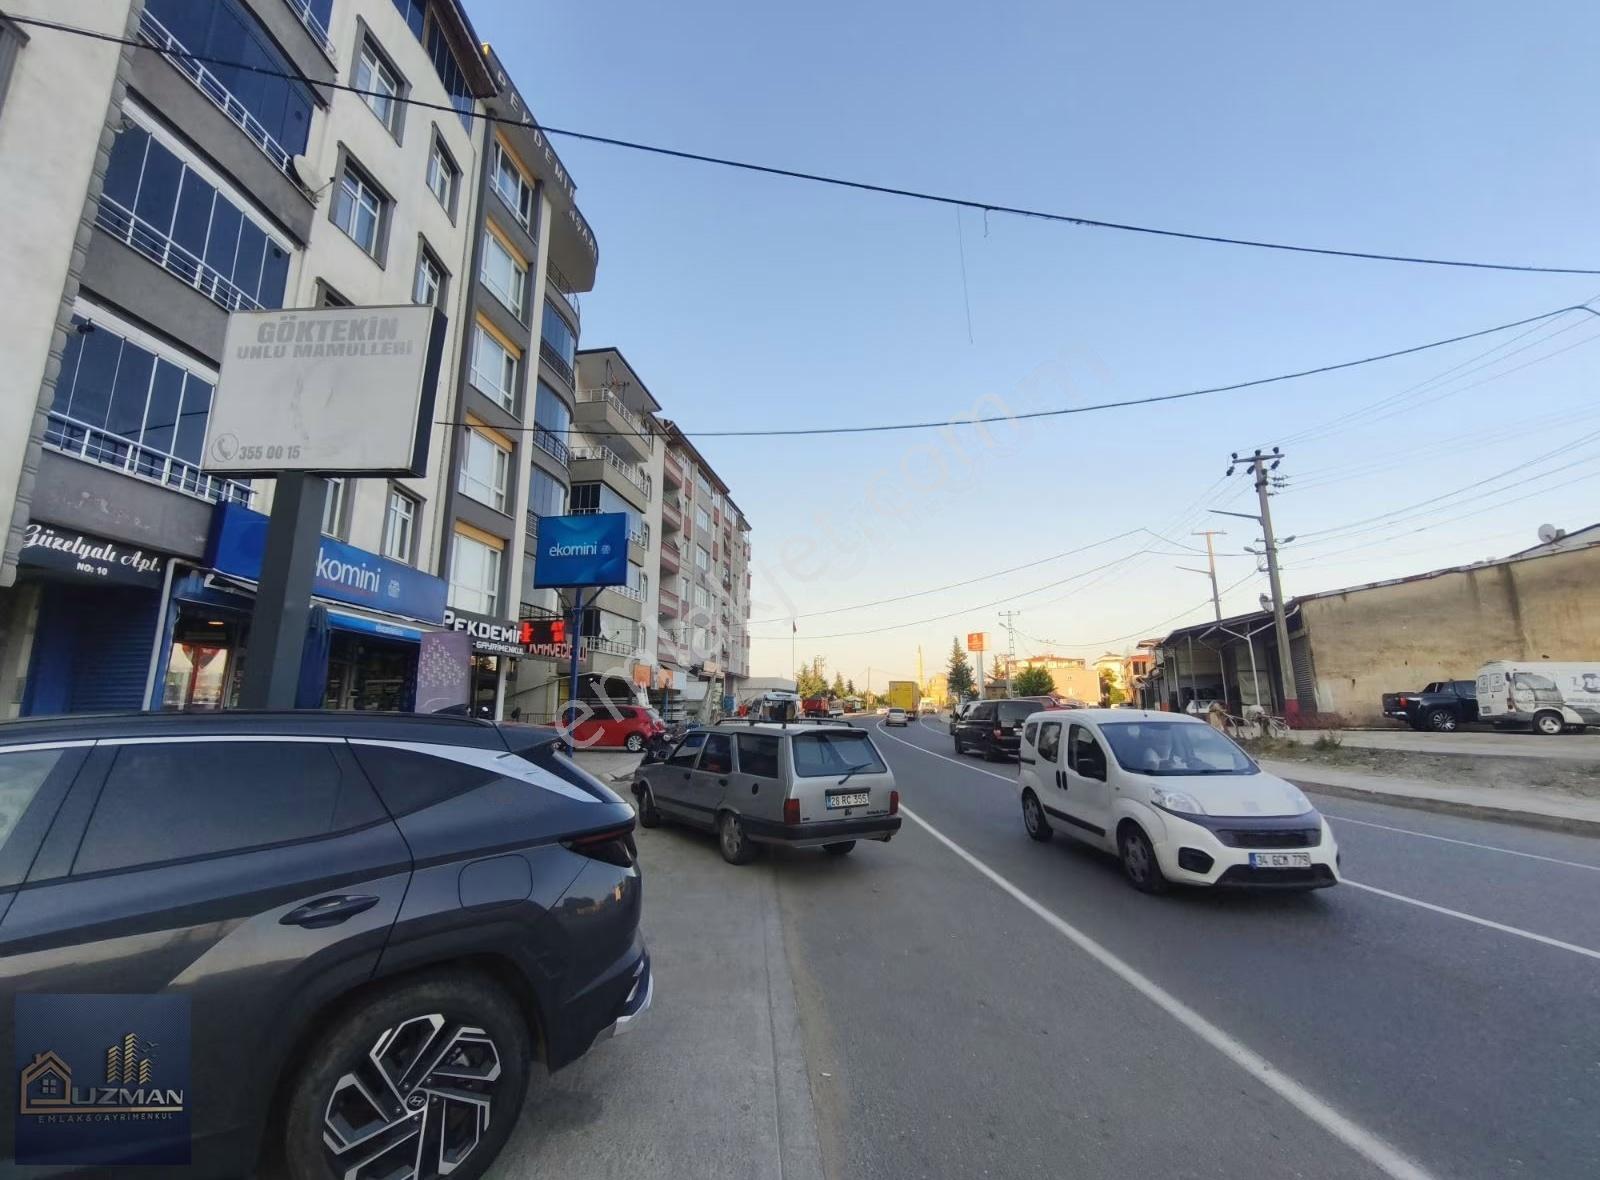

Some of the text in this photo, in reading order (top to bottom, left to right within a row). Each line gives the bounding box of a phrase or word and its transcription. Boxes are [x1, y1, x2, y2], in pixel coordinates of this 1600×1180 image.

[256, 315, 399, 344] GÖKTEKİN
[238, 445, 301, 462] 355 00 15
[548, 540, 598, 557] ekomini
[76, 562, 109, 576] NO: 10
[120, 551, 162, 573] Apt.
[315, 547, 381, 593] komini
